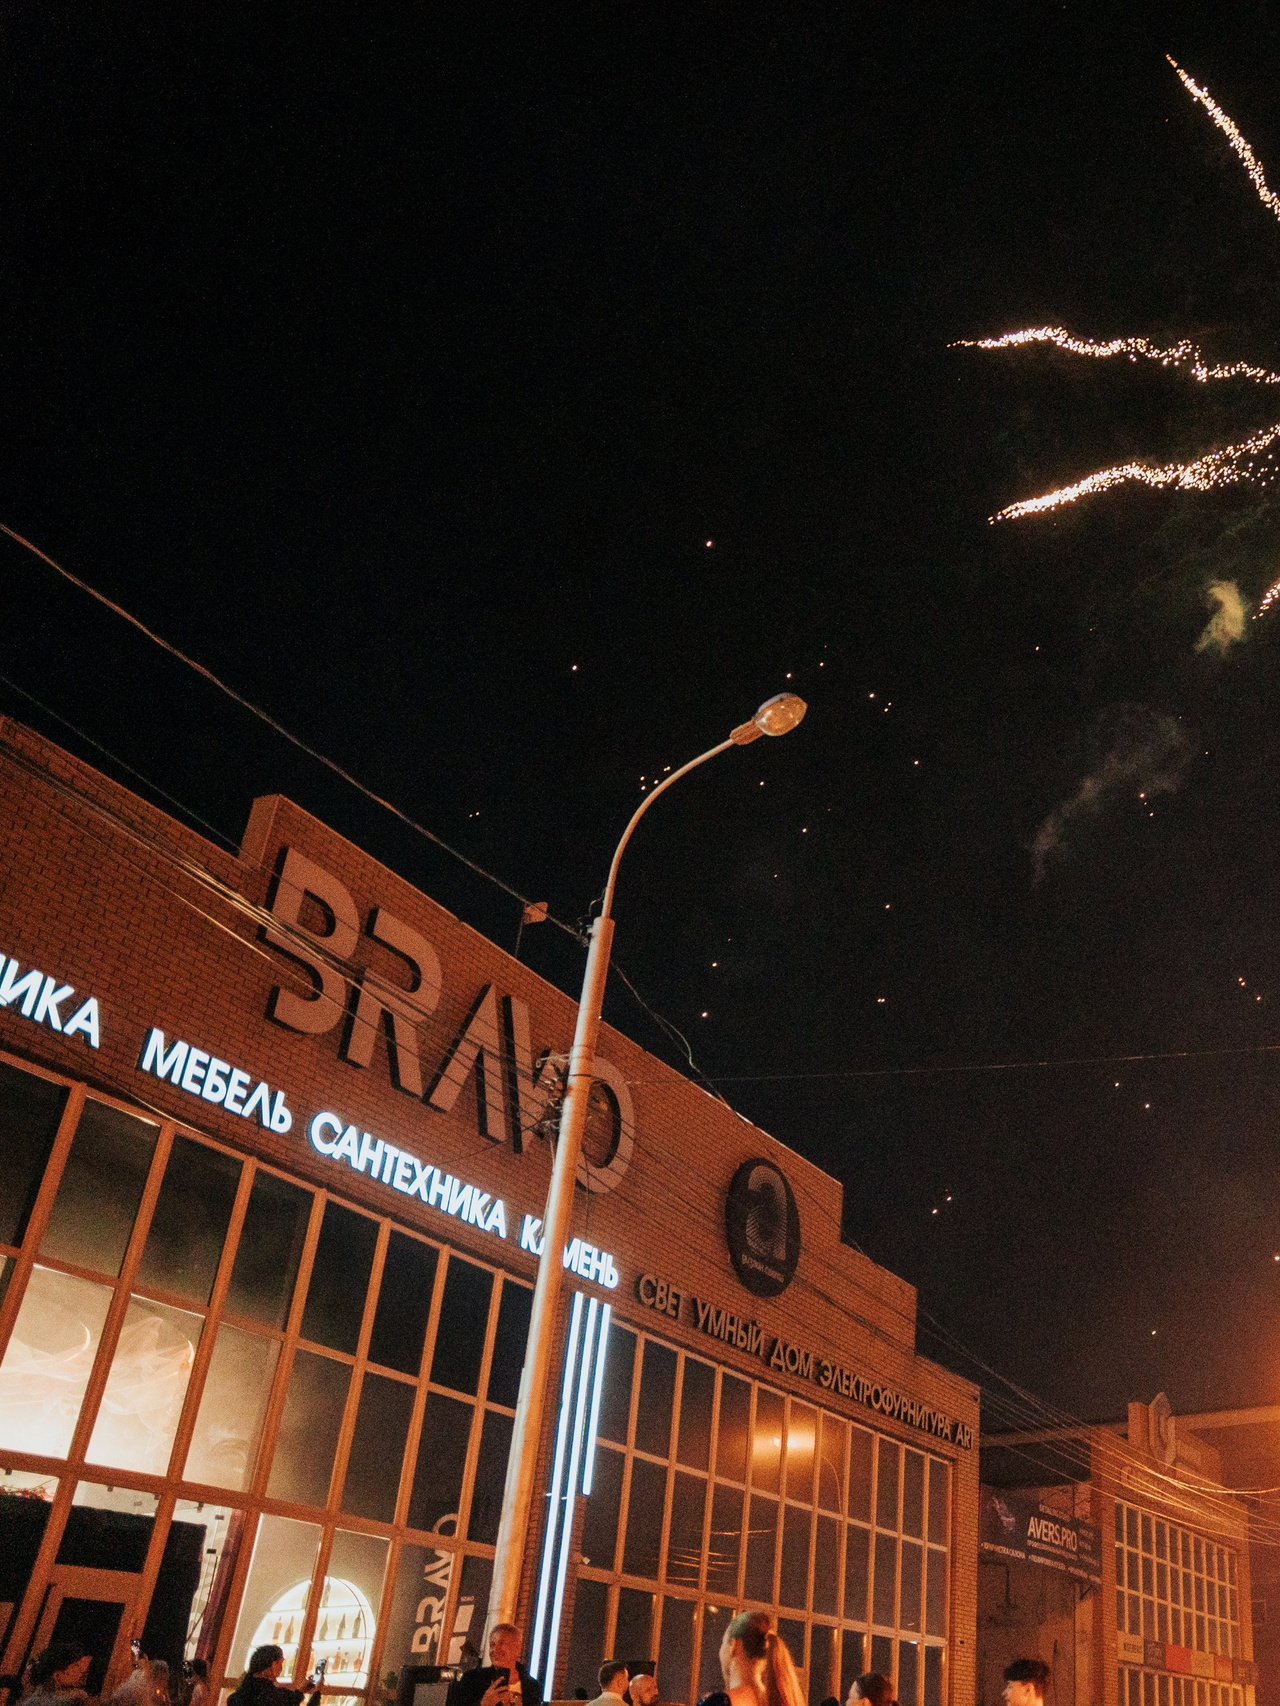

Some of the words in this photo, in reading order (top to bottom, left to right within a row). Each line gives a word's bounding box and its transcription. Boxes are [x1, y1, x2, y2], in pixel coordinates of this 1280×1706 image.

[272, 846, 637, 1194] BRAVO
[0, 953, 100, 1049] ИКА
[142, 1027, 293, 1134] МЕБЕЛЬ
[309, 1112, 507, 1238] САНТЕХНИКА
[638, 1273, 686, 1320] СВЕТ
[695, 1298, 764, 1358] УМНЫЙ
[770, 1339, 815, 1380] ДОМ
[819, 1359, 952, 1441] ЭЛЕКТРОФУРНИТУРА
[1027, 1516, 1078, 1552] AVERS.PRO
